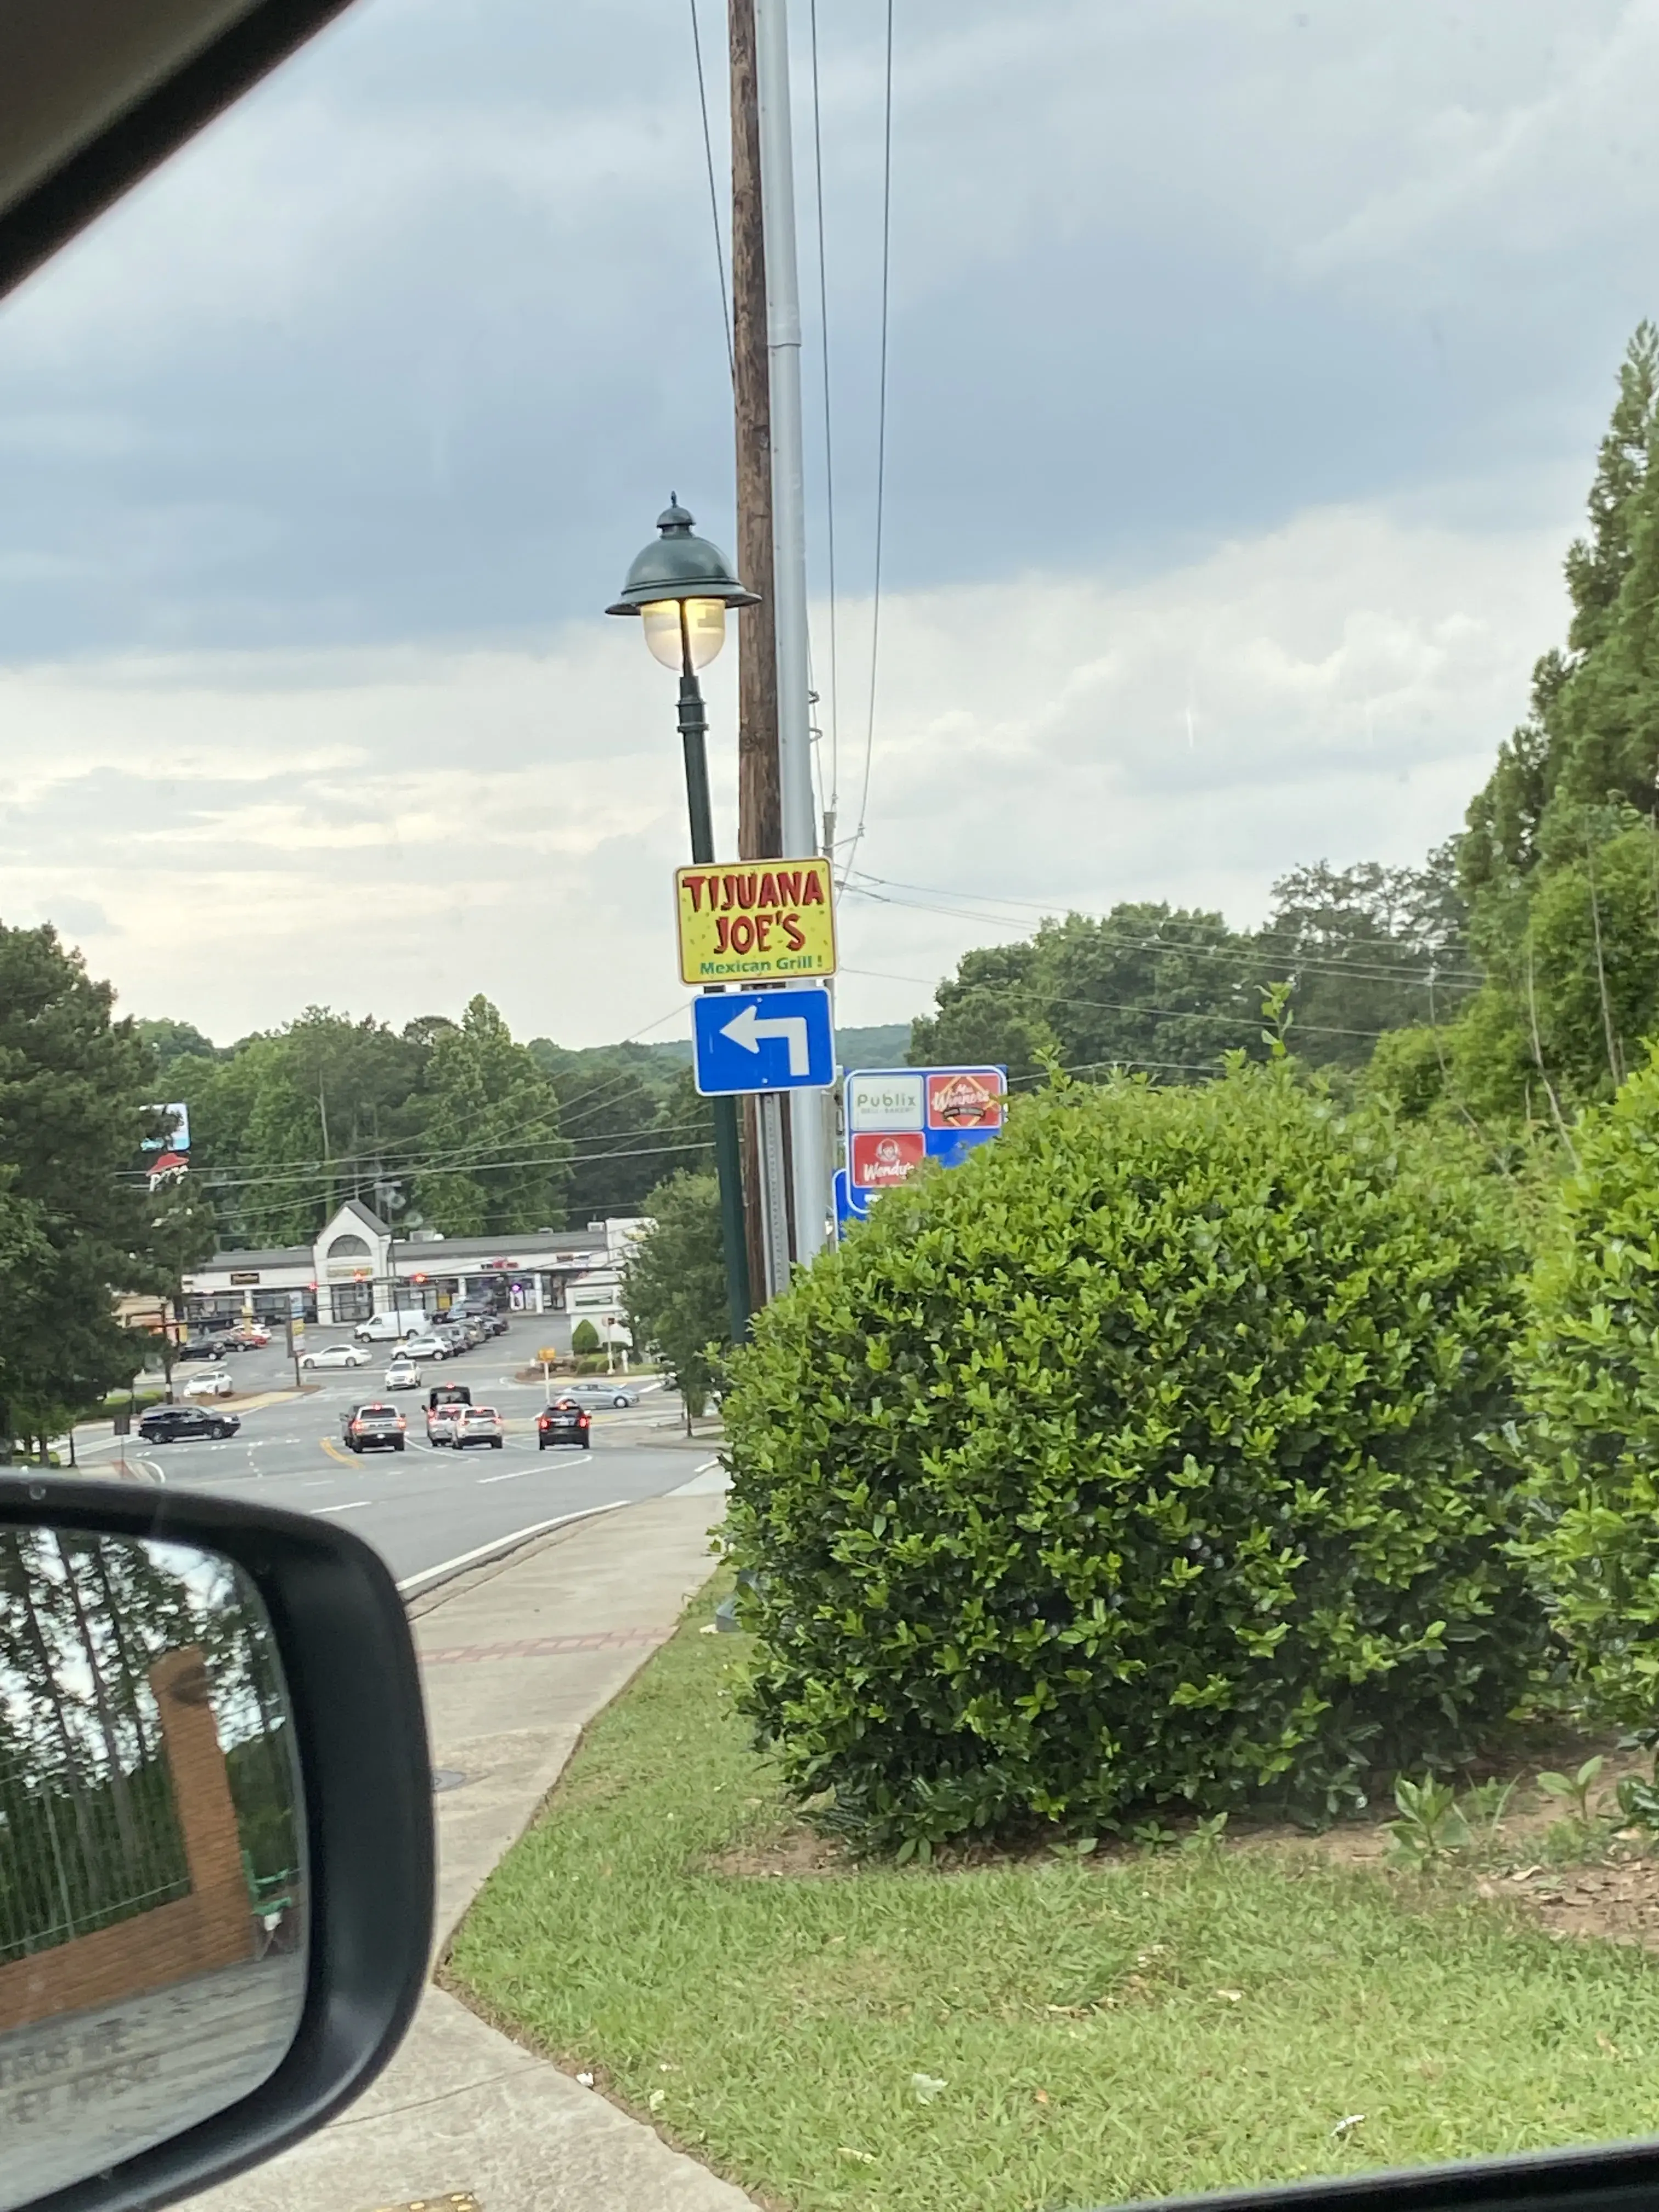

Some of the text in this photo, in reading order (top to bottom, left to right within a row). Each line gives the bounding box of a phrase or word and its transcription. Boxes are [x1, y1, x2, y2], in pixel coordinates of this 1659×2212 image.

[682, 870, 825, 913] TIJUANA
[713, 910, 806, 955] JOE'S
[699, 960, 771, 975] Mexican
[857, 1093, 916, 1108] Publix
